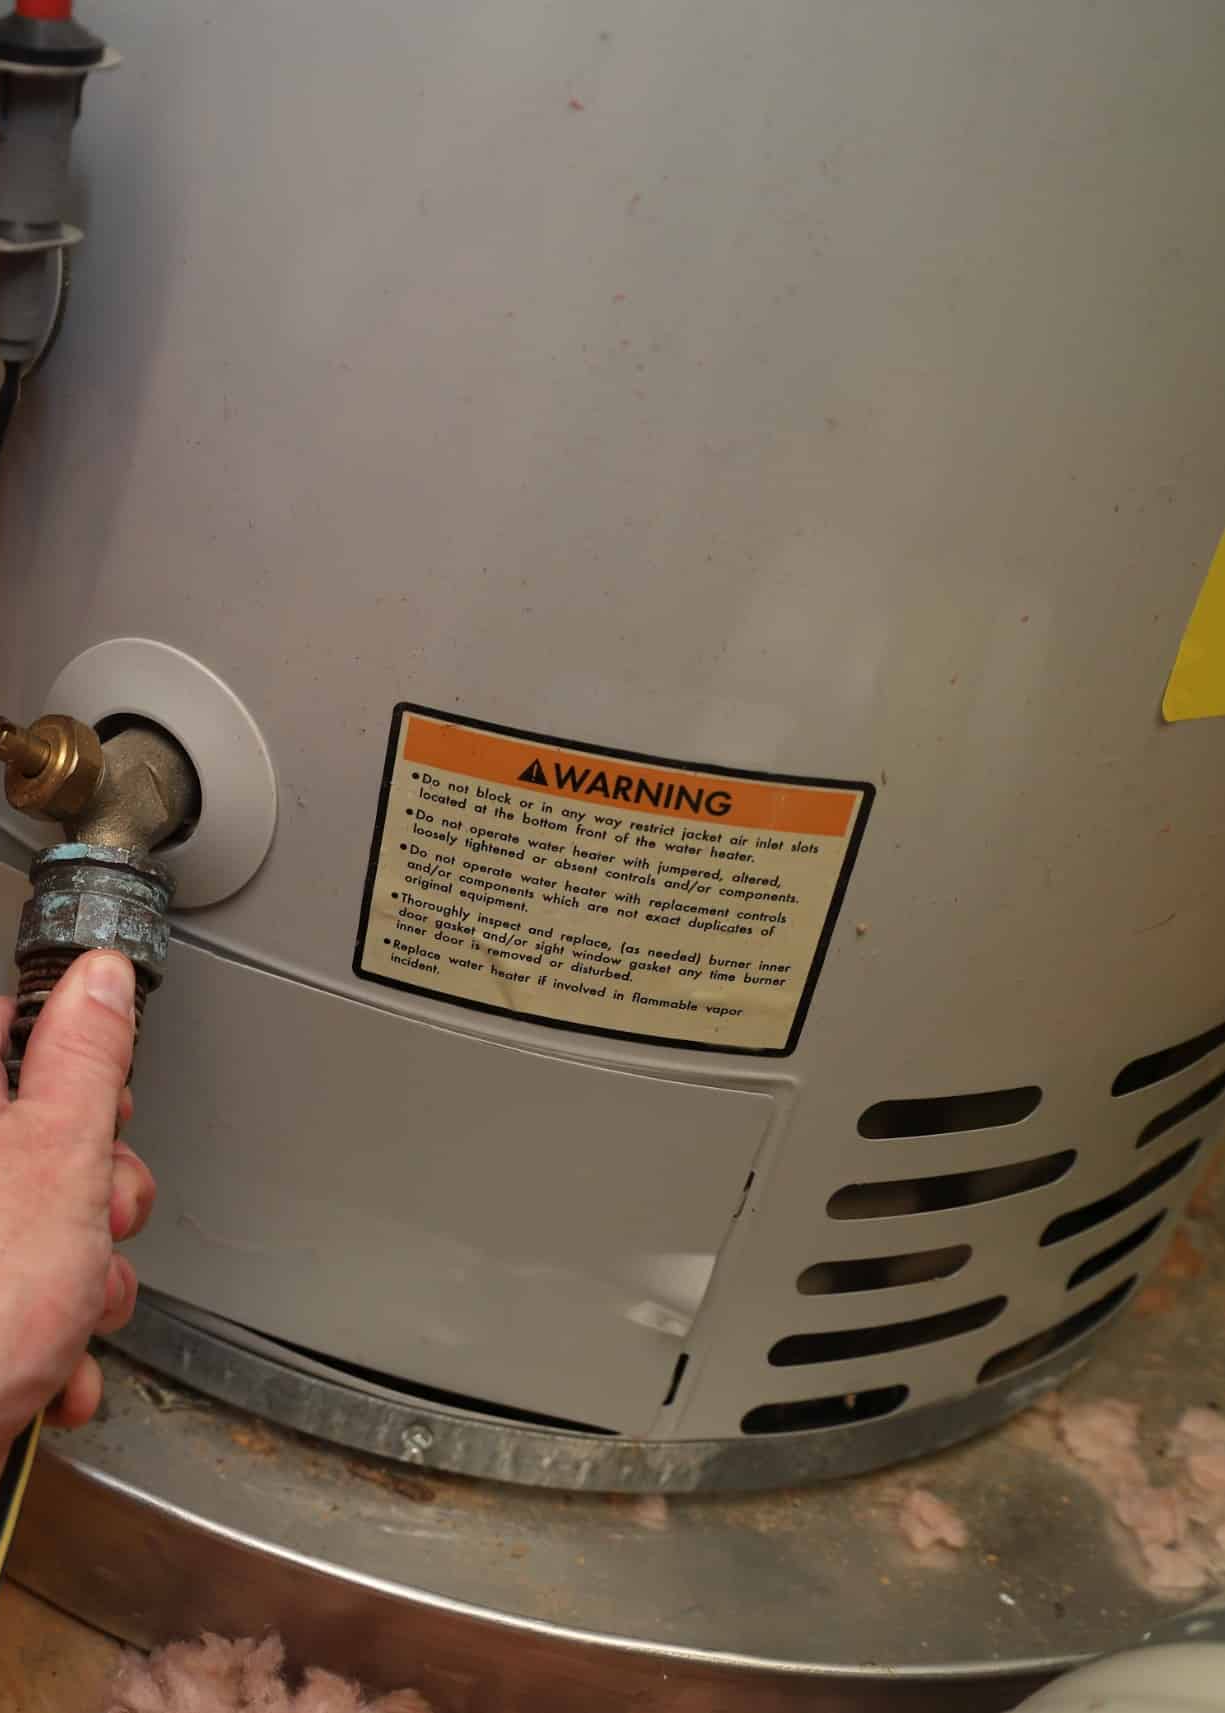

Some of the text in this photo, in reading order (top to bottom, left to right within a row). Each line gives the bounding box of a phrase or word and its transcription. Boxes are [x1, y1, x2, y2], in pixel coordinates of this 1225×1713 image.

[419, 786, 755, 863] located at the bottom front of the water heater.
[422, 772, 819, 854] Do not block or in any way restrict jacket air inlet slots
[554, 762, 732, 817] WARNING
[409, 844, 787, 924] Do not operate water heater with replacement controls
[413, 822, 800, 903] loosely tightened or absent controls and/or components.
[415, 808, 781, 889] Do not operate water heater with jumpered, altered,
[401, 892, 792, 973] Thoroughly inspect and replace, (as needed) burner inner
[404, 875, 528, 912] original equipment.
[407, 861, 776, 936] and/or components which are not exact duplicates of
[390, 952, 440, 975] incident.
[392, 938, 743, 1017] Replace water heater if involved in flammable vapor
[396, 919, 633, 982] inner door is removed or disturbed.
[398, 906, 787, 987] door gasket and/or sight window gasket any time burner
